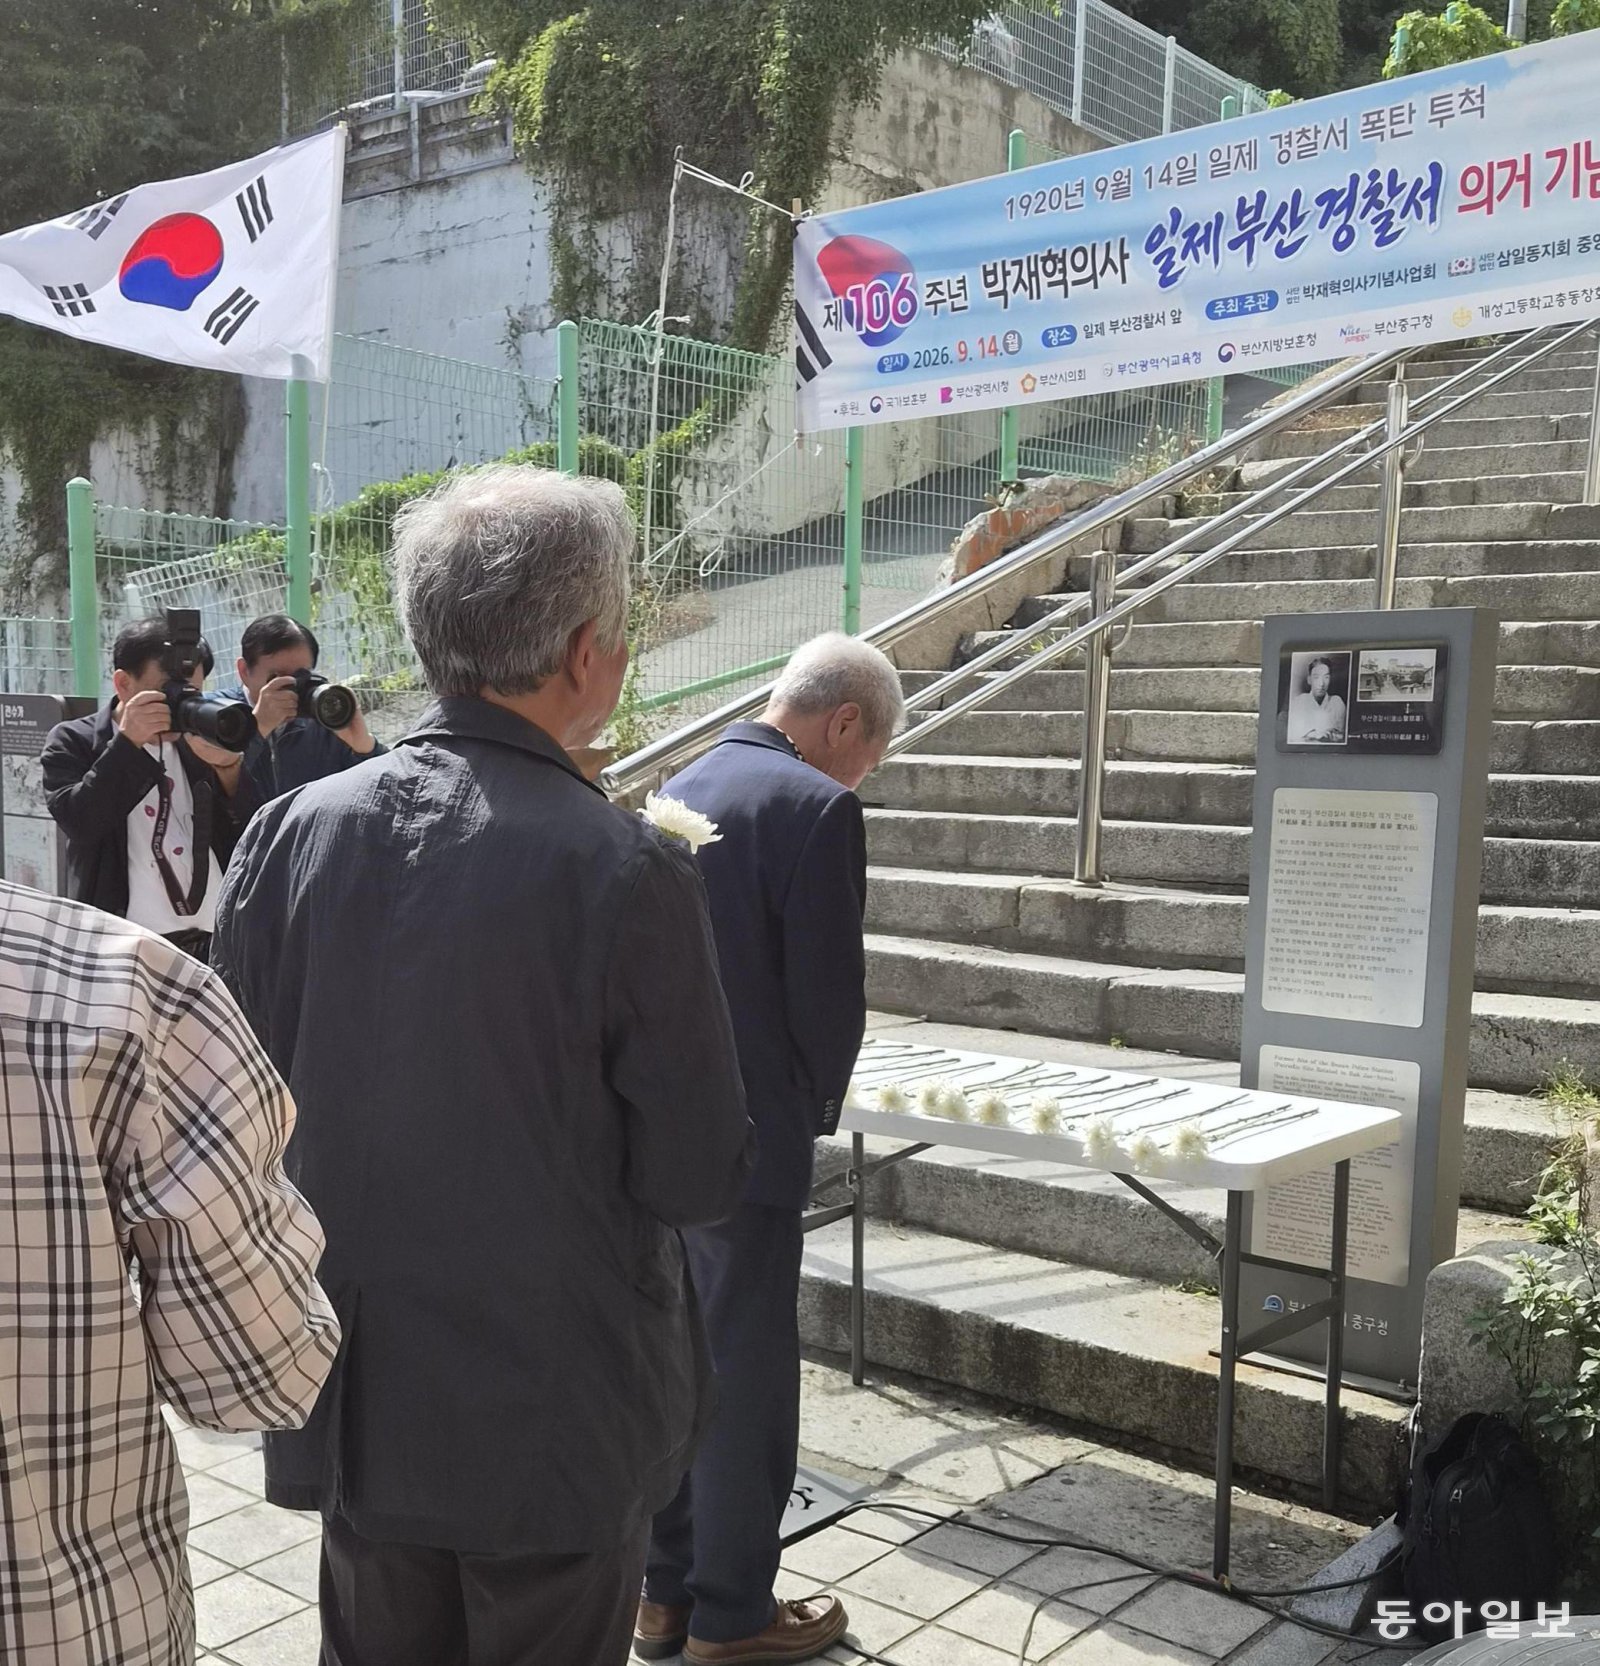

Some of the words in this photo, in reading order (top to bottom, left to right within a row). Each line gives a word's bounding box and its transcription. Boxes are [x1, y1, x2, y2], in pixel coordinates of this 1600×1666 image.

[1005, 179, 1085, 220] 1920년
[1094, 169, 1132, 201] 9월
[1144, 153, 1197, 190] 14일
[1208, 138, 1258, 179] 일제
[1270, 117, 1349, 165] 경찰서
[1361, 102, 1416, 143] 폭탄
[1427, 84, 1485, 129] 투척
[982, 237, 1129, 309] 박재혁의사
[1458, 153, 1531, 216] 의거
[1497, 238, 1571, 268] 삼일동지회
[1302, 263, 1437, 300] 박재혁의사기념사업회
[1048, 328, 1072, 346] 장소
[1083, 322, 1105, 339] 일제
[1109, 310, 1166, 334] 부산경찰서
[1170, 308, 1183, 324] 앞
[1374, 314, 1433, 336] 부산중구청
[882, 356, 905, 372] 일시
[913, 347, 953, 369] 2026.
[1005, 332, 1019, 352] 월
[956, 381, 1010, 398] 부산광역시청
[1039, 368, 1086, 387] 부산시의회
[1117, 351, 1202, 375] 부산광역시교육청
[1241, 332, 1317, 356] 부산지방보훈청
[1352, 1313, 1388, 1336] 중구청
